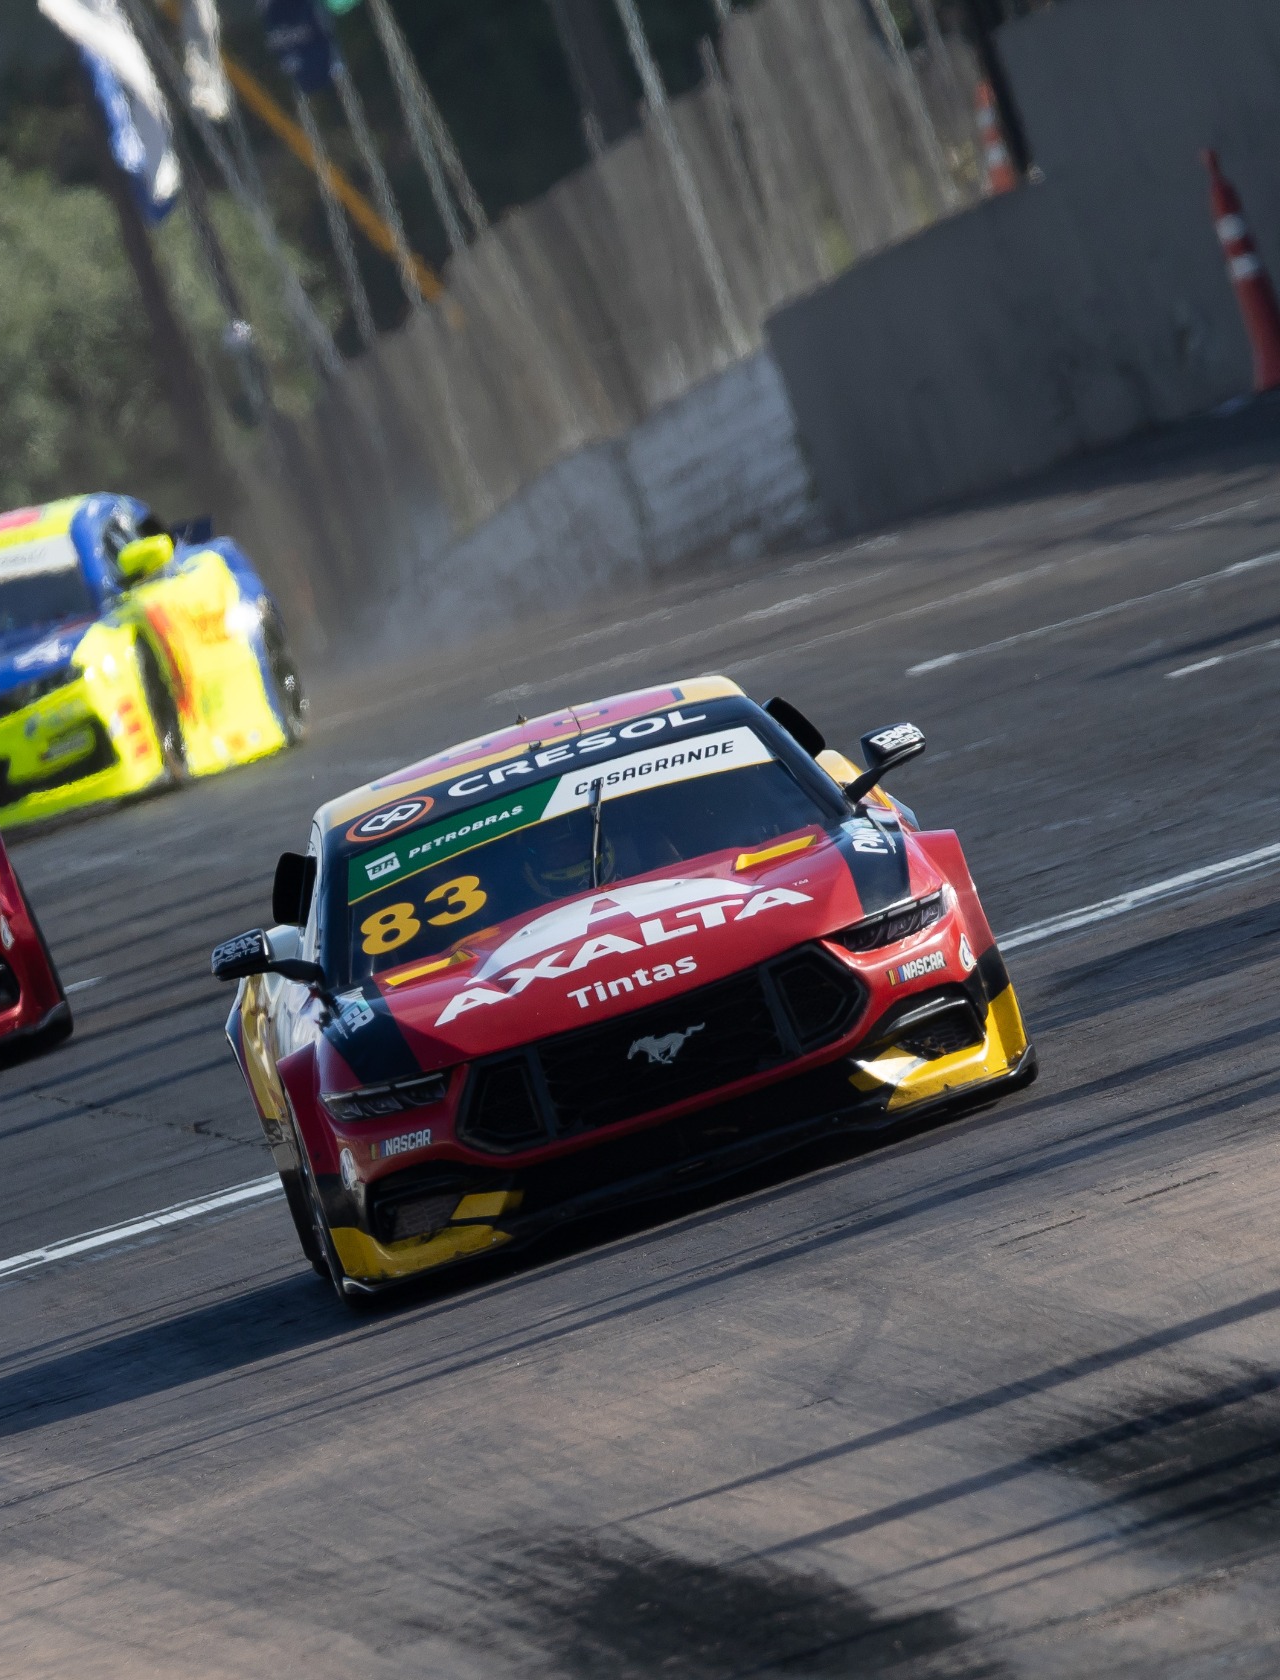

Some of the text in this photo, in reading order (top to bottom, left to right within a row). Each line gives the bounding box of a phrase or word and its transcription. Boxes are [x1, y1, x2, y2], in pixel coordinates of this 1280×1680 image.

[448, 710, 706, 797] CRESOL
[869, 722, 922, 747] DRAX
[574, 740, 735, 797] CASAGRANDE
[408, 805, 524, 859] PETROBRAS
[360, 875, 487, 955] 83
[213, 934, 261, 959] DRAX
[213, 946, 261, 968] SPORTS
[434, 887, 814, 1027] AXALTA
[902, 951, 946, 983] NASCAR
[567, 955, 698, 1009] Tintas
[385, 1129, 432, 1156] NASCAR
